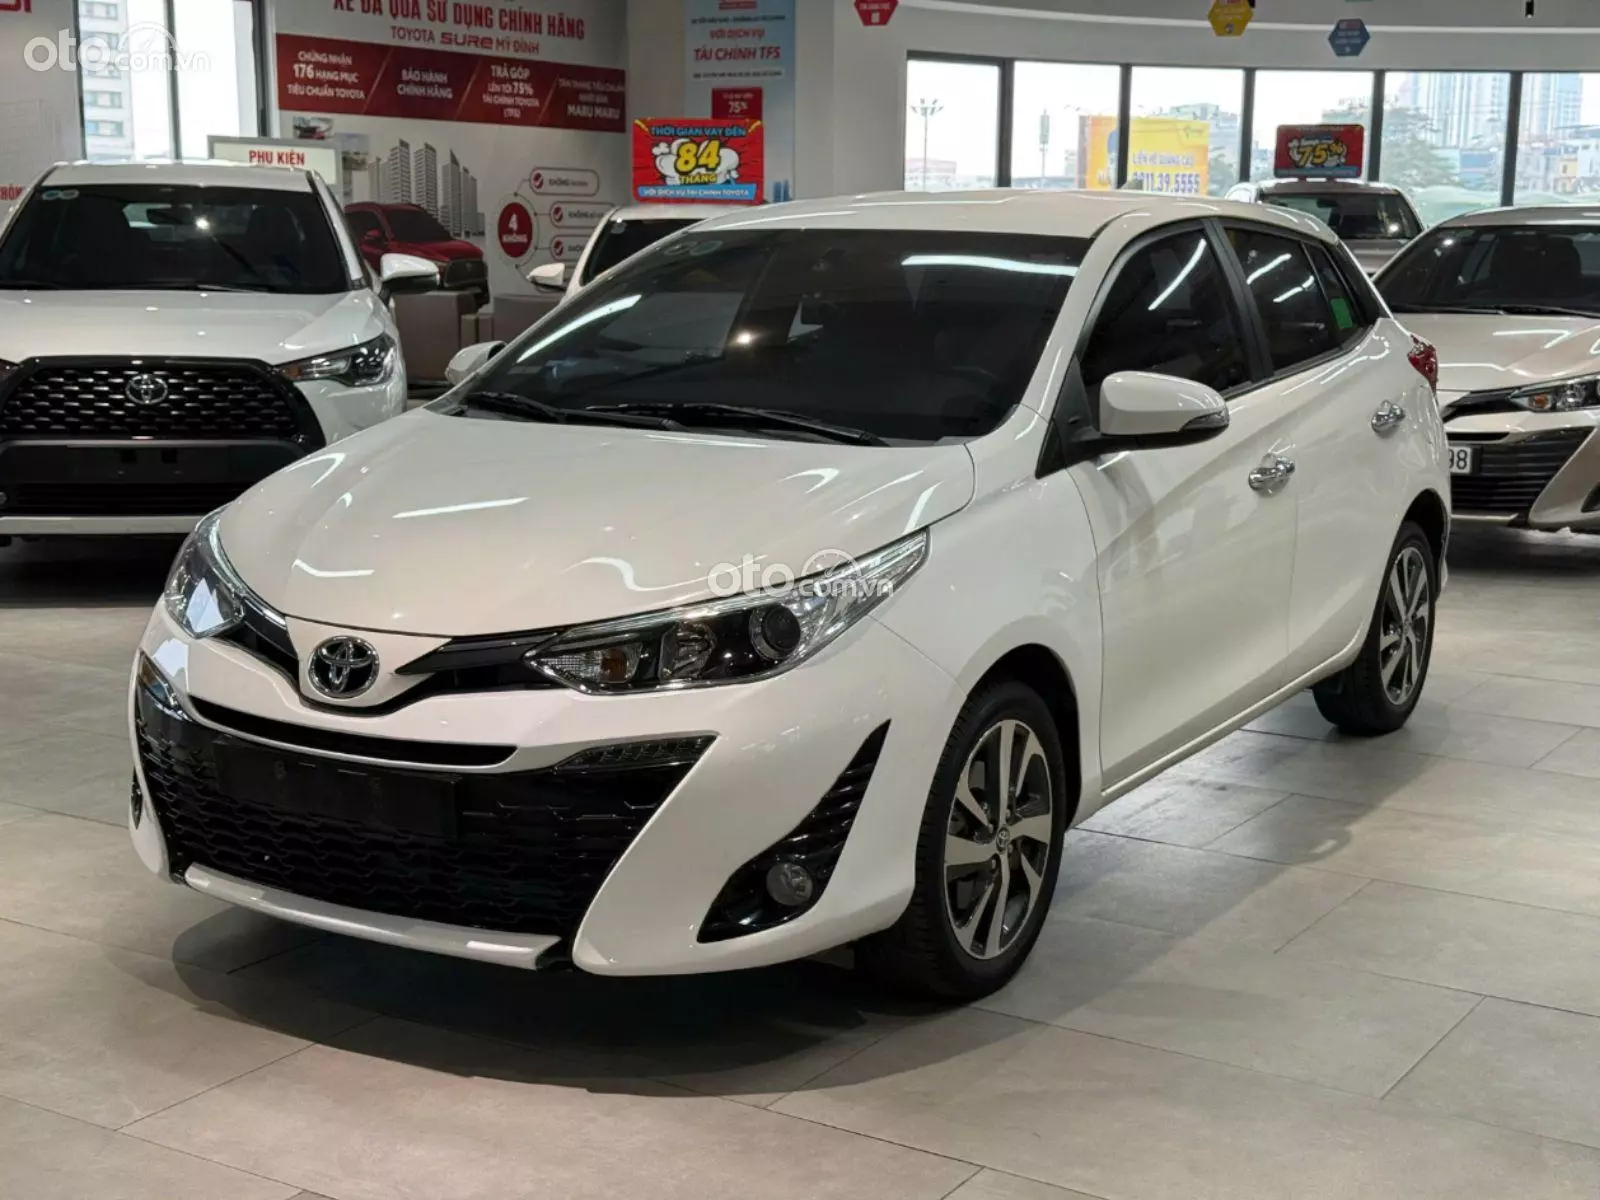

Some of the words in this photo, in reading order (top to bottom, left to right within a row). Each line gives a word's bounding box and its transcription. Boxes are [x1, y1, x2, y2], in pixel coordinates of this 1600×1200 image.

[390, 25, 436, 44] TOYOTA
[693, 44, 713, 61] TÀI
[293, 63, 315, 79] 176
[335, 87, 366, 99] TOYOTA
[676, 127, 702, 136] GIAN
[703, 127, 723, 136] VAY
[674, 140, 722, 175] 84
